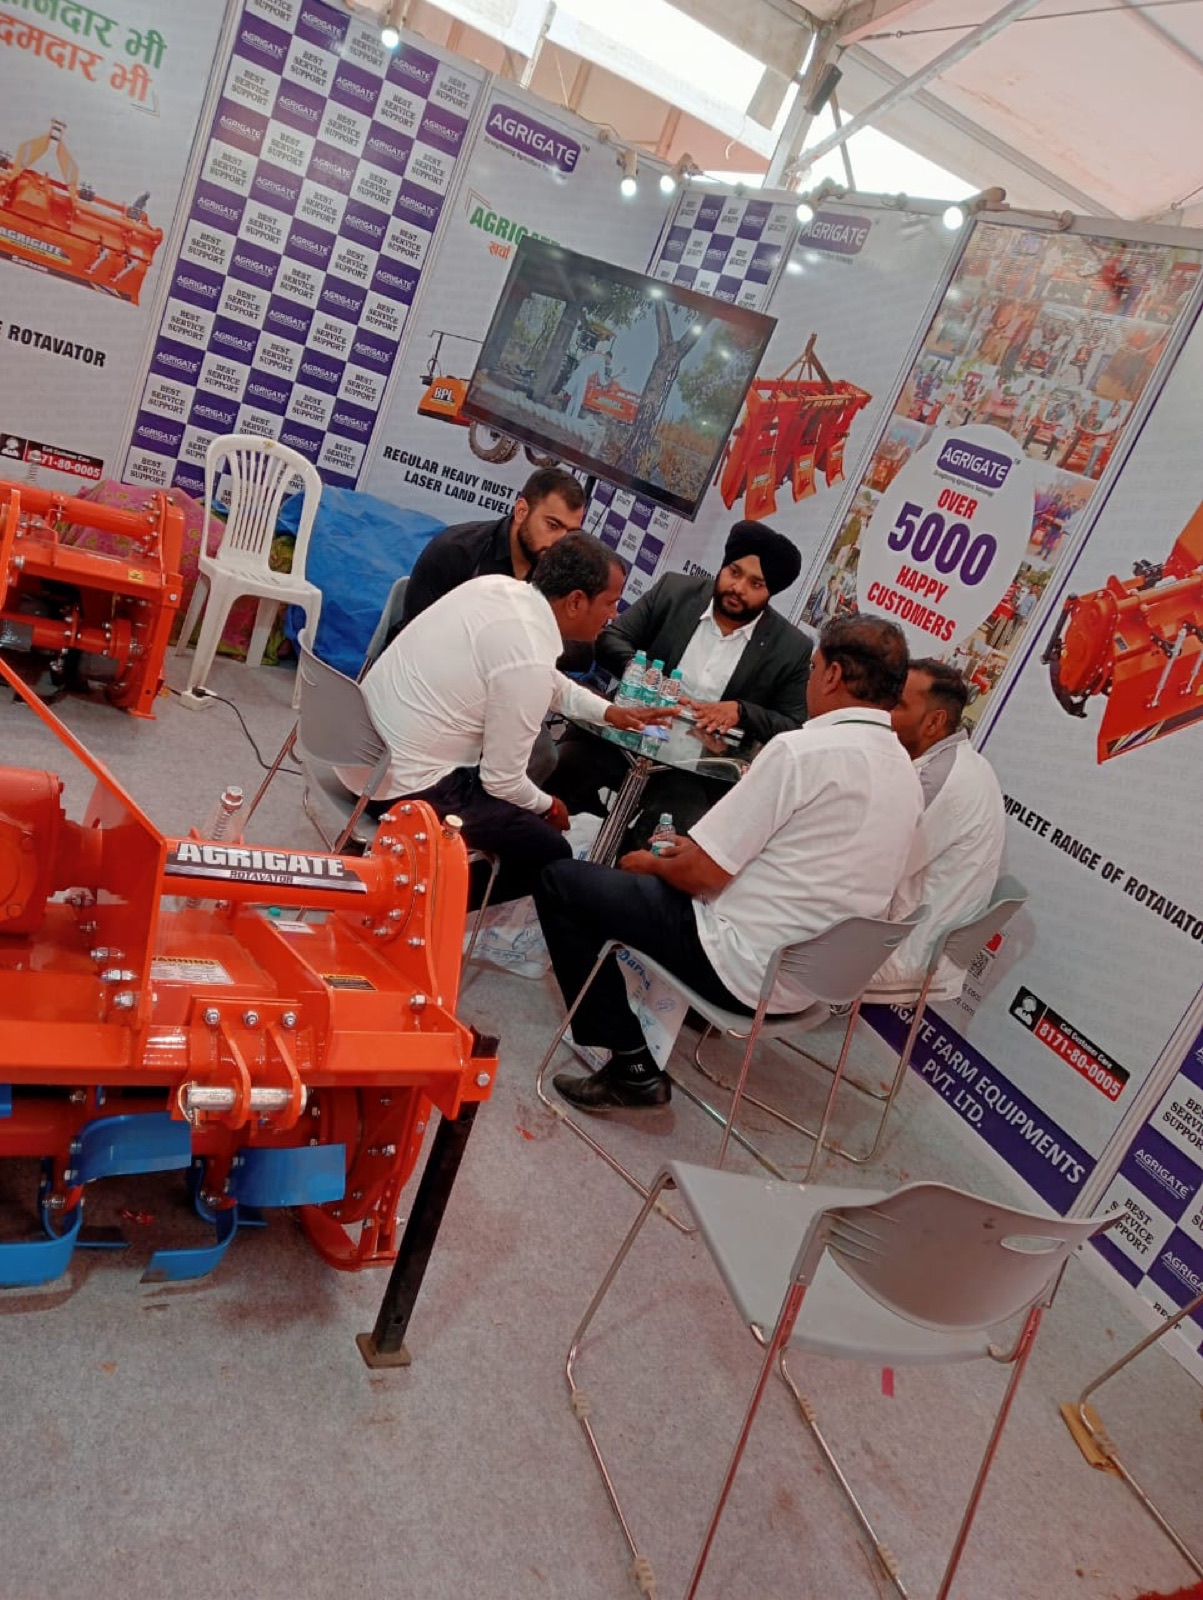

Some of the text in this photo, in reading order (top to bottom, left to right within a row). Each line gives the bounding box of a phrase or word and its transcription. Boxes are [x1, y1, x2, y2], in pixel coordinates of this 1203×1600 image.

[125, 28, 167, 69] भी
[110, 62, 152, 101] भी
[489, 113, 577, 167] AGRIGATE
[196, 195, 239, 219] AGRIGATE
[256, 211, 278, 226] BEST
[469, 206, 560, 246] AGRIG
[199, 232, 221, 247] BEST
[289, 232, 329, 255] AGRIGATE
[800, 221, 868, 246] AGRIGATE
[233, 253, 274, 276] AGRIGATE
[345, 247, 365, 262] BEST
[176, 273, 218, 296] AGRIGATE
[290, 268, 312, 282] BEST
[375, 267, 412, 289] AGRIGATE
[235, 288, 257, 303] BEST
[322, 288, 360, 309] AGRIGATE
[178, 309, 200, 323] BEST
[268, 308, 307, 330] AGRIGATE
[376, 301, 395, 315] BEST
[323, 321, 343, 335] BEST
[8, 324, 106, 367] ROTAVATOR
[212, 329, 253, 350] AGRIGATE
[269, 342, 290, 356] BEST
[353, 340, 390, 360] AGRIGATE
[156, 349, 197, 371] AGRIGATE
[214, 362, 236, 376] BEST
[301, 361, 338, 381] AGRIGATE
[158, 383, 181, 397] BEST
[354, 372, 373, 386] BEST
[247, 381, 286, 401] AGRIGATE
[302, 393, 322, 406] BEST
[193, 402, 233, 422] AGRIGATE
[249, 414, 270, 427] BEST
[332, 411, 368, 430] AGRIGATE
[137, 423, 178, 443] AGRIGATE
[281, 431, 318, 450] AGRIGATE
[333, 442, 353, 454] BEST
[41, 453, 101, 479] 71-80-0005
[140, 455, 162, 468] BEST
[940, 446, 1009, 481] AGRIGATE
[383, 446, 439, 475] REGULAR
[441, 466, 481, 488] HEAVY
[480, 479, 514, 500] MUST
[403, 470, 442, 492] LASER
[445, 484, 476, 504] LAND
[478, 495, 514, 516] LEVEL
[937, 488, 978, 520] OVER
[887, 500, 997, 586] 5000
[895, 565, 949, 604] HAPPY
[867, 581, 956, 641] CUSTOMERS
[177, 842, 344, 877] AGRIGATE
[230, 869, 293, 884] ROTAVATOR
[1050, 829, 1102, 871] RANGE
[1101, 861, 1125, 884] OF
[1123, 876, 1203, 944] ROTAVATO
[1039, 1023, 1121, 1097] 8171-80-0005
[922, 1059, 984, 1128] PVT. LTD.
[931, 1034, 979, 1082] FARM
[975, 1076, 1085, 1184] EQUIPMENTS
[1170, 1101, 1203, 1138] SERVI
[1162, 1111, 1203, 1150] SUPPOR
[1134, 1149, 1189, 1198] AGRIGATE
[1110, 1200, 1154, 1245] SRVICE
[1124, 1197, 1152, 1226] BEST
